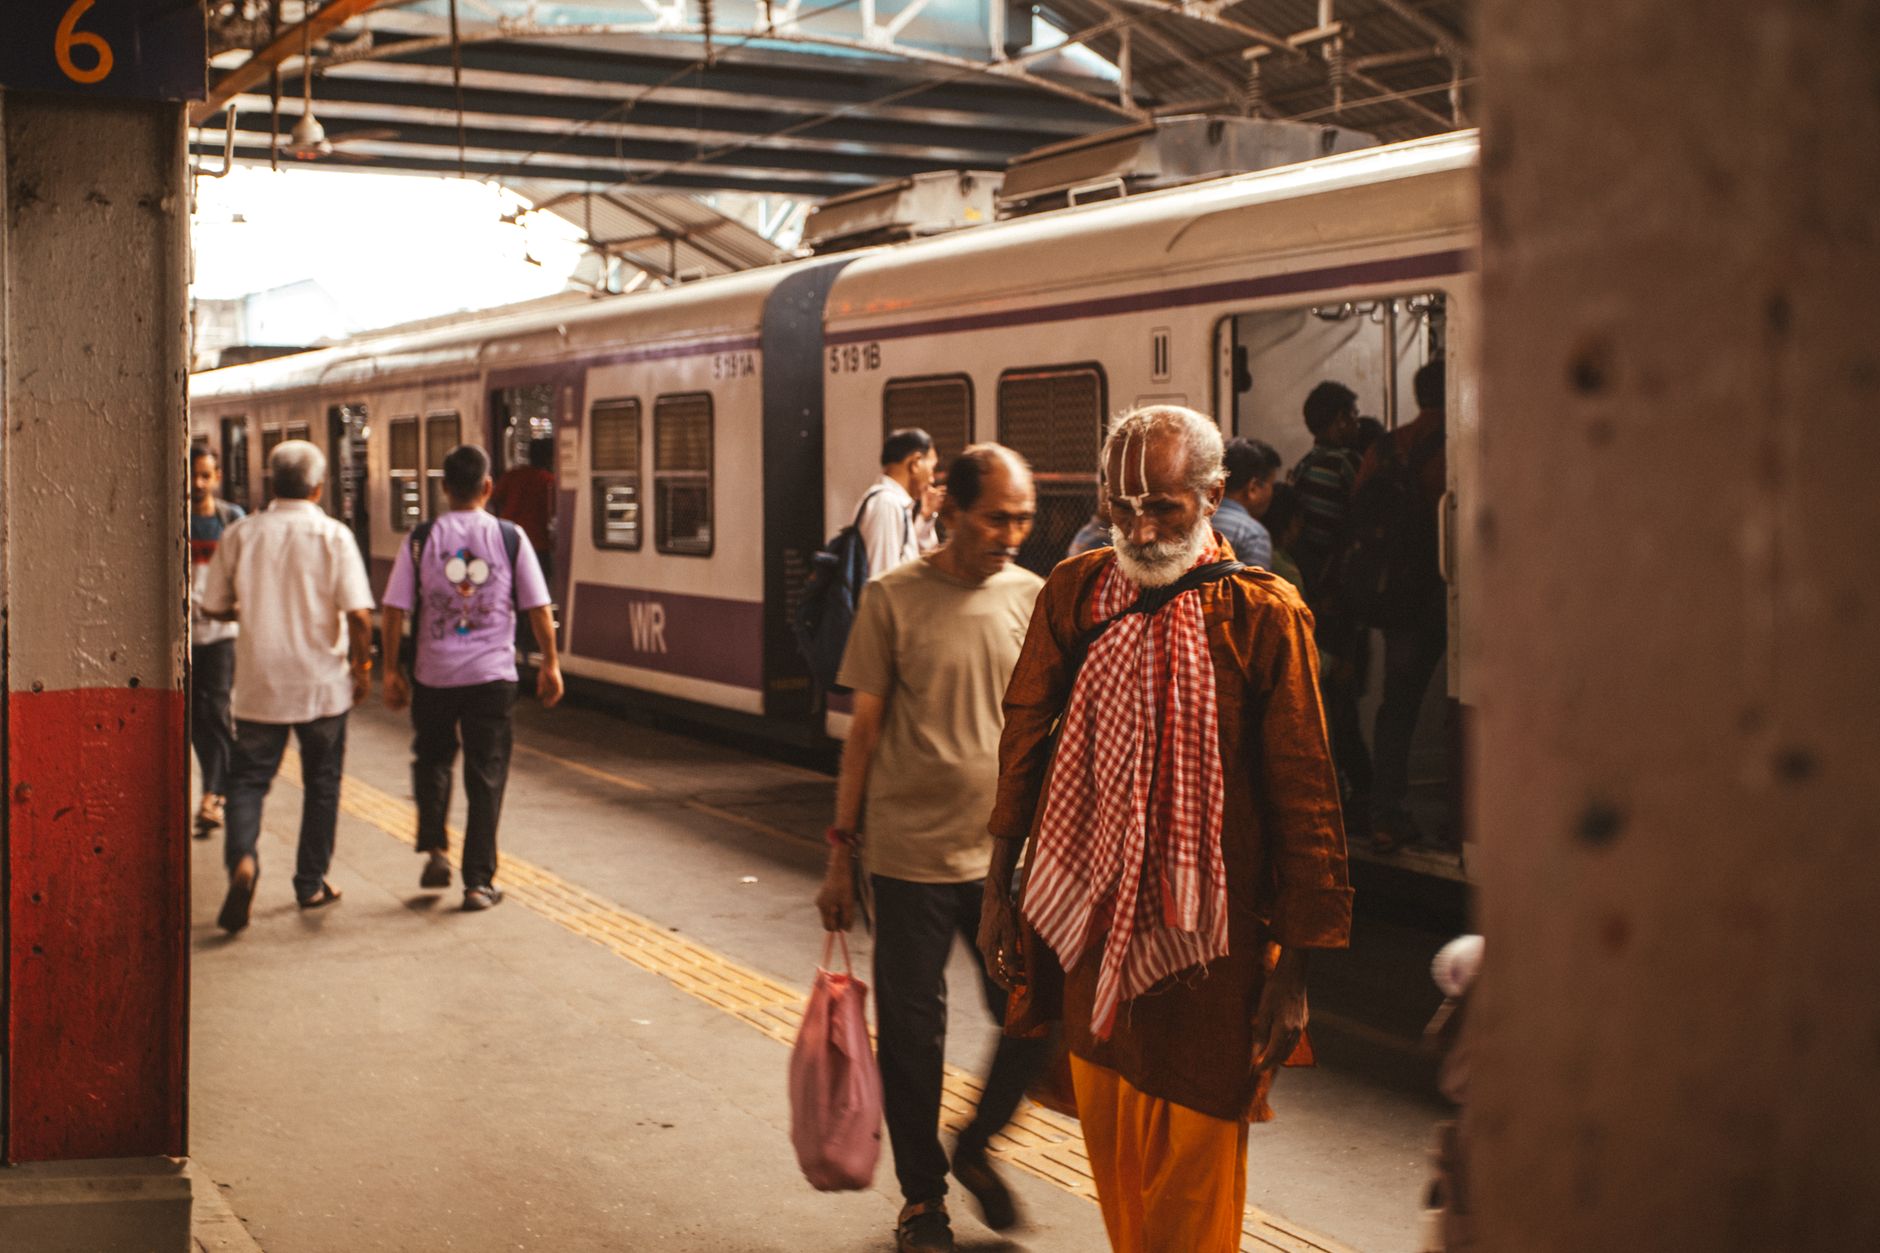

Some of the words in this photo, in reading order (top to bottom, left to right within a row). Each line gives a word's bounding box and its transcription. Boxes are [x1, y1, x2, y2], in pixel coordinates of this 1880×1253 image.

[54, 0, 114, 84] 6
[830, 341, 882, 374] 5191B
[628, 602, 669, 654] WR
